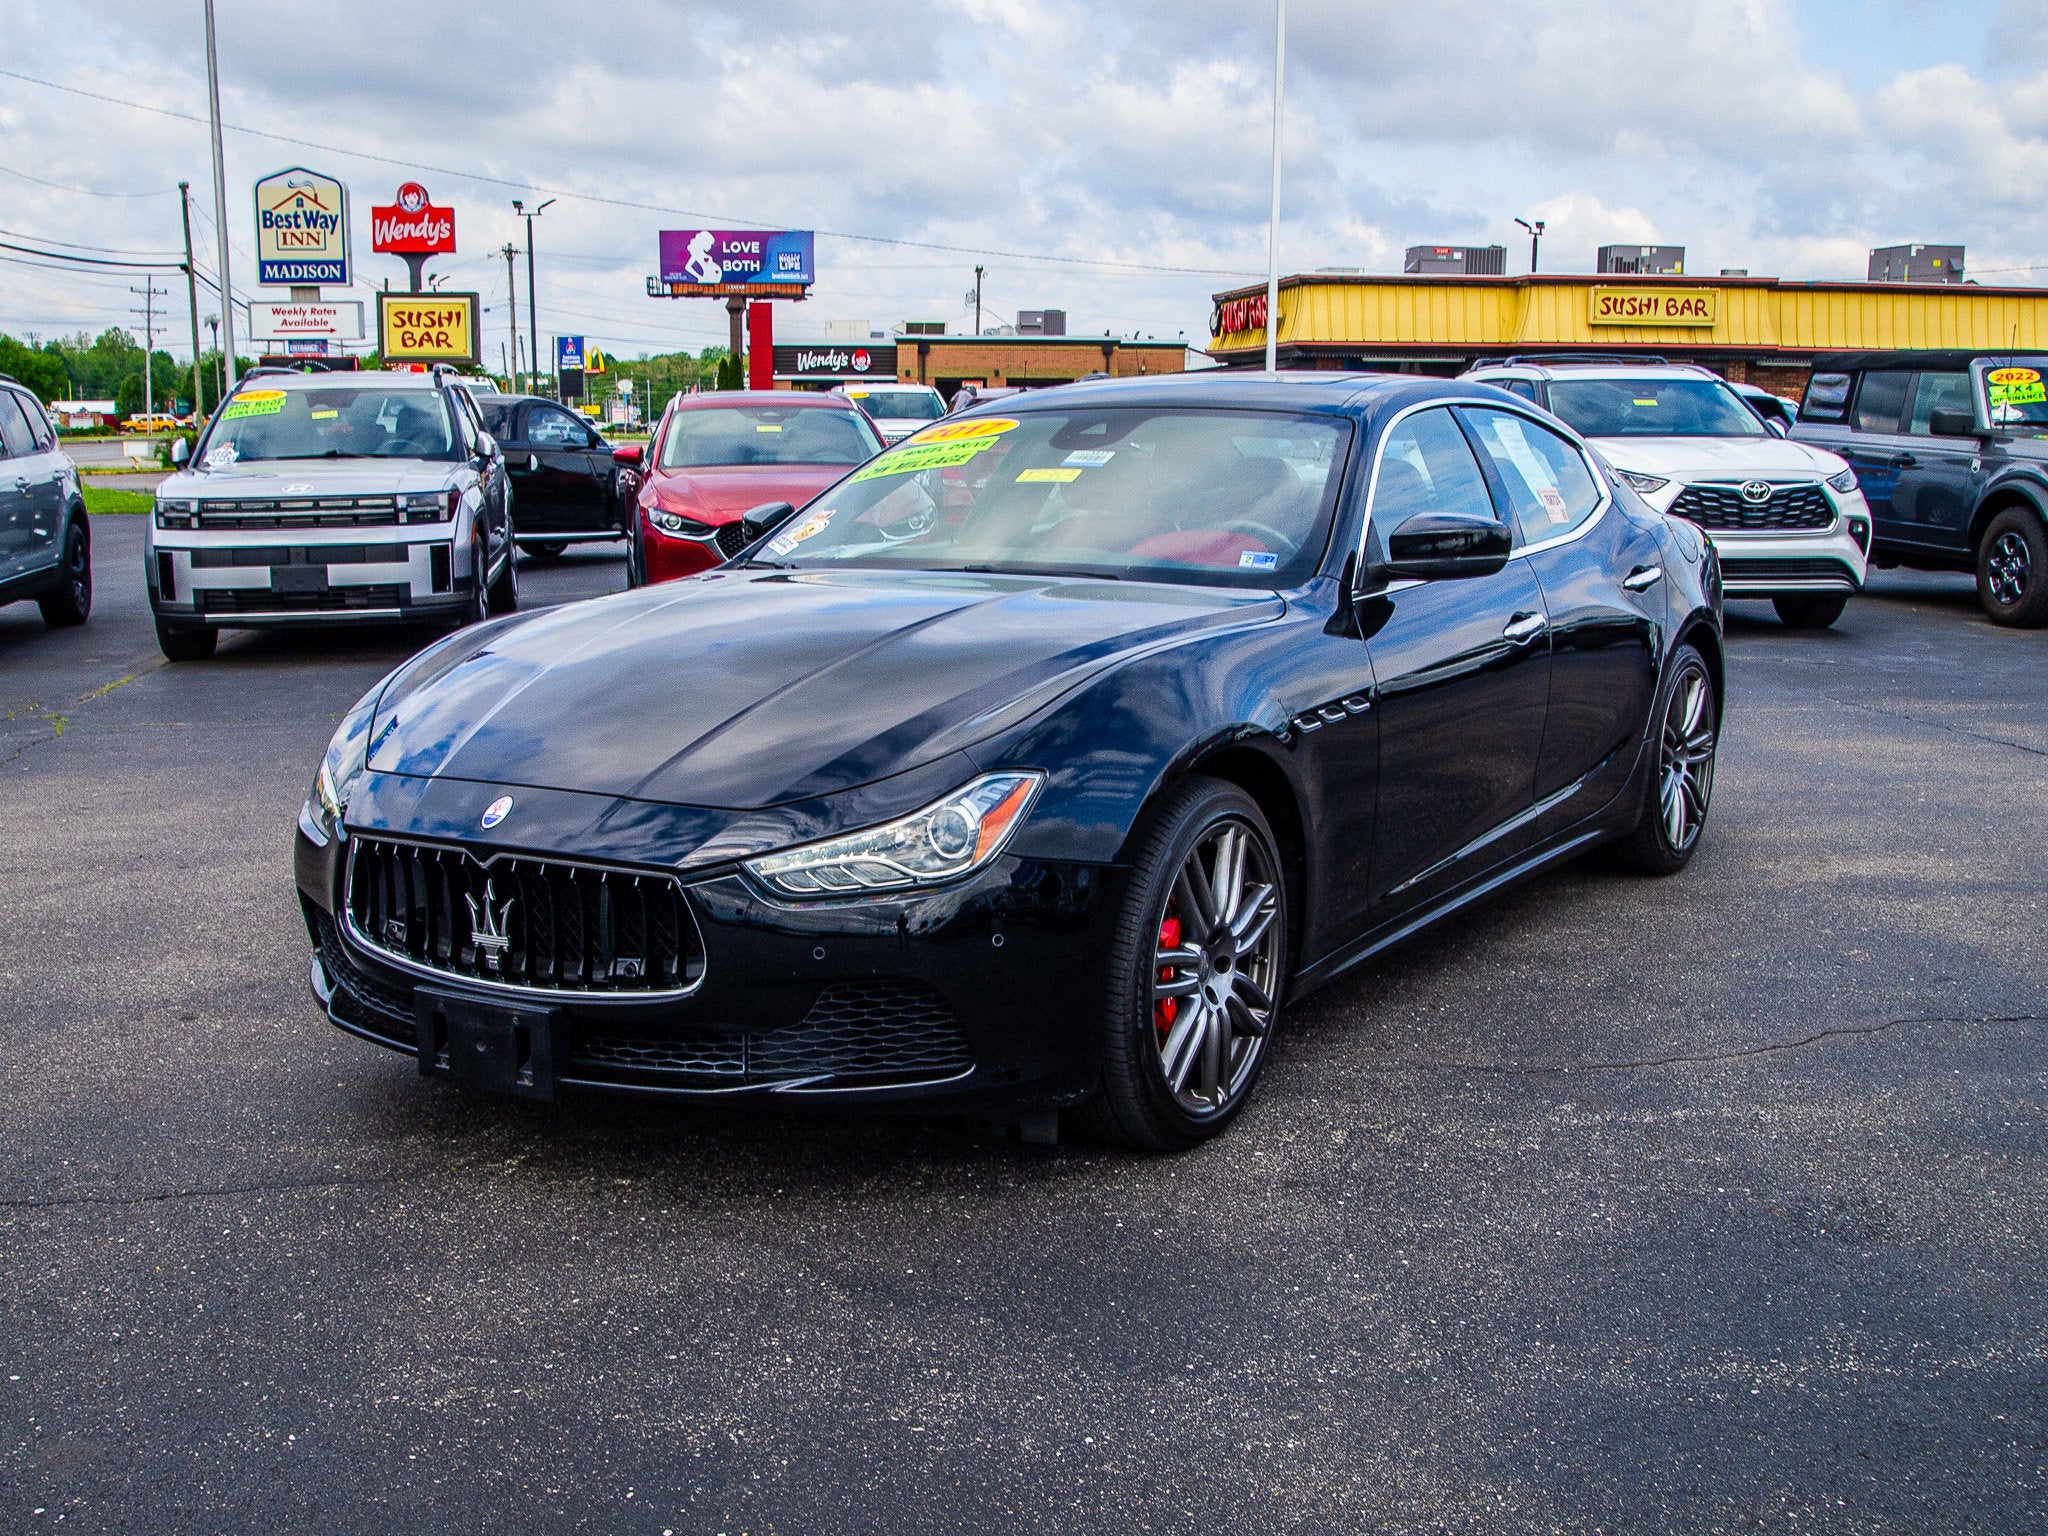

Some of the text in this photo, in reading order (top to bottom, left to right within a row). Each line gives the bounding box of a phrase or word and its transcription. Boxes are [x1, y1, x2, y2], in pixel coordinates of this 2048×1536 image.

[262, 209, 339, 235] Best Way
[374, 213, 451, 246] Wendy's
[281, 231, 321, 246] INN
[722, 241, 760, 253] LOVE
[264, 265, 341, 279] MADISON
[722, 260, 760, 272] BOTH
[272, 307, 337, 317] Weekly Rates
[1600, 297, 1708, 317] SUSHI BAR
[281, 318, 328, 327] Available
[392, 311, 461, 328] SUSHI
[1222, 300, 1247, 334] SUSHI
[401, 331, 453, 348] BAR
[797, 348, 849, 372] Wendy's
[1995, 372, 2034, 382] 2022
[2007, 393, 2043, 402] FINANCE
[920, 421, 1011, 442] 2017
[947, 440, 992, 451] DRIVE
[893, 453, 972, 471] MILEAGE
